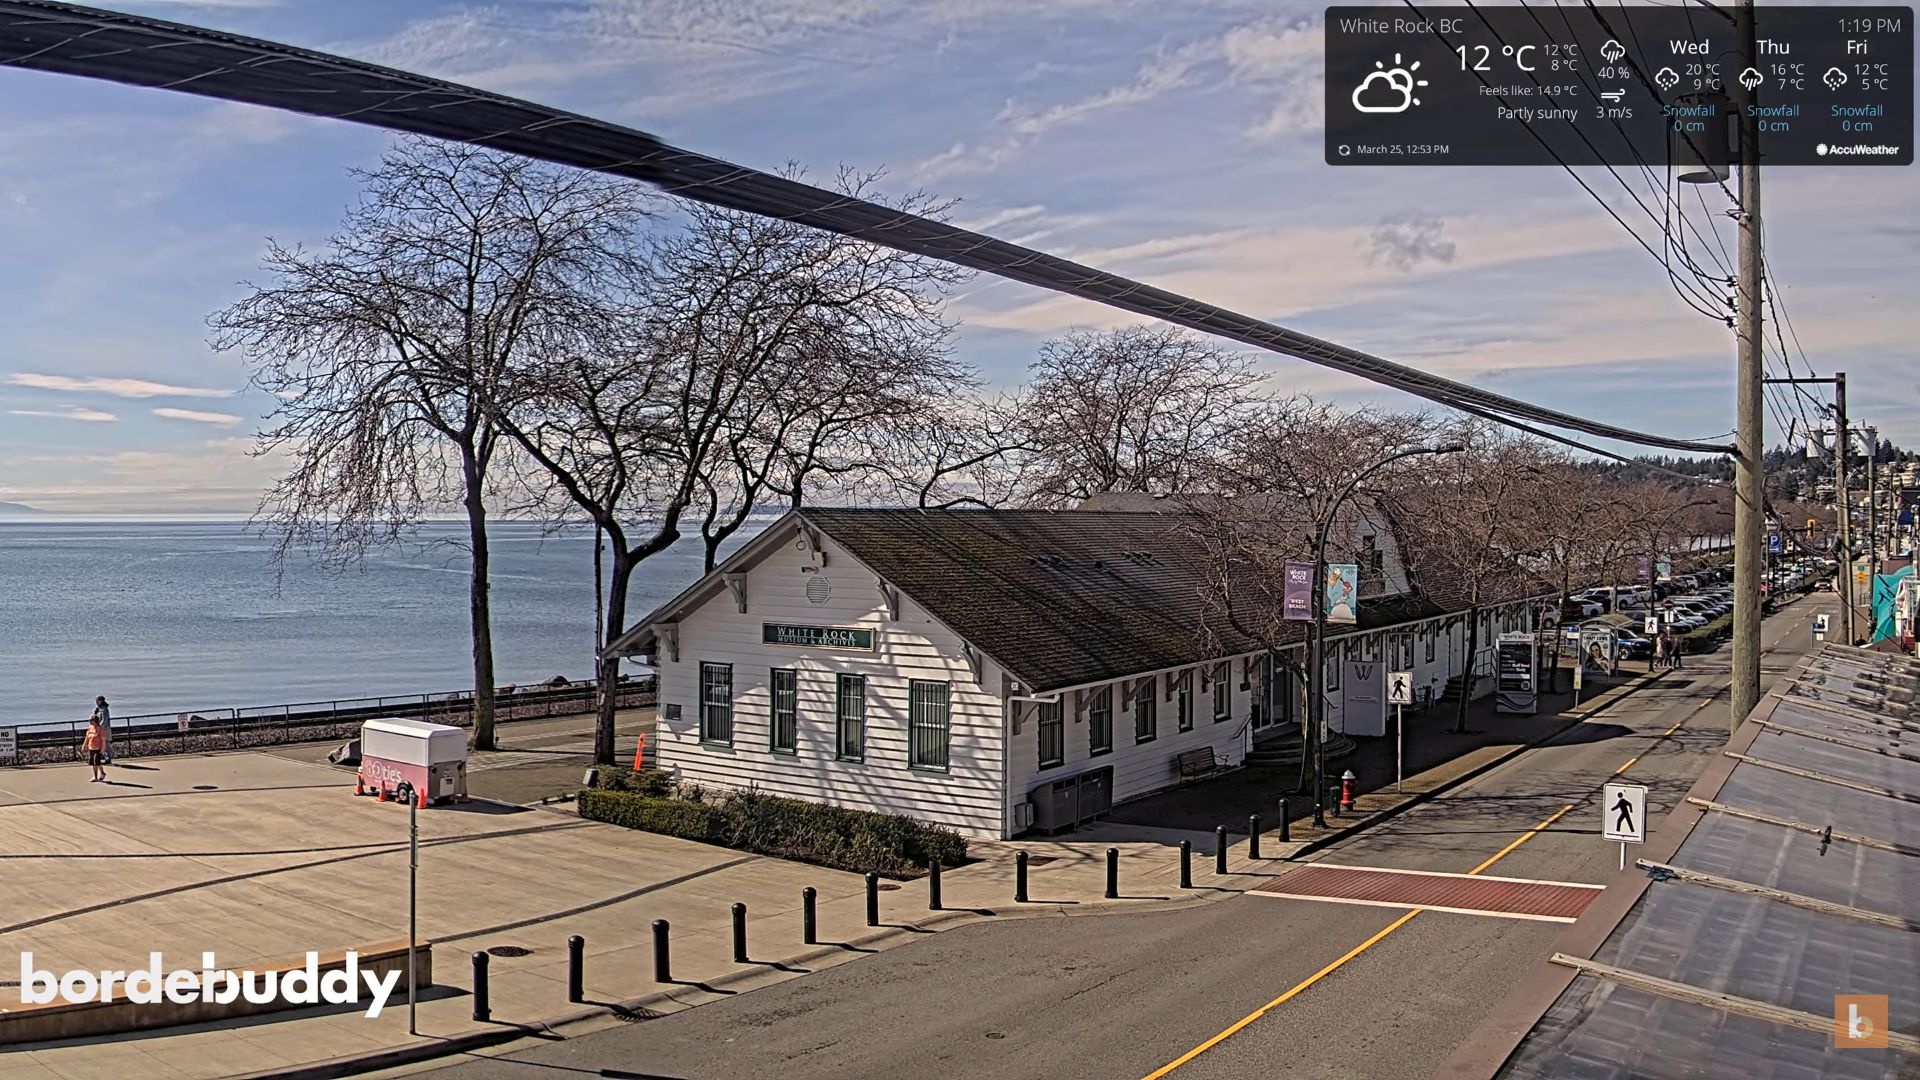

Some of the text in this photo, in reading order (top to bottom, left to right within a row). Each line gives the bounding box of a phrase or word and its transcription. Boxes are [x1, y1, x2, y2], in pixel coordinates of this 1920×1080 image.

[776, 626, 857, 641] WHITE ROCK
[778, 636, 808, 644] MUSEUM
[818, 639, 856, 647] ARCHIVES
